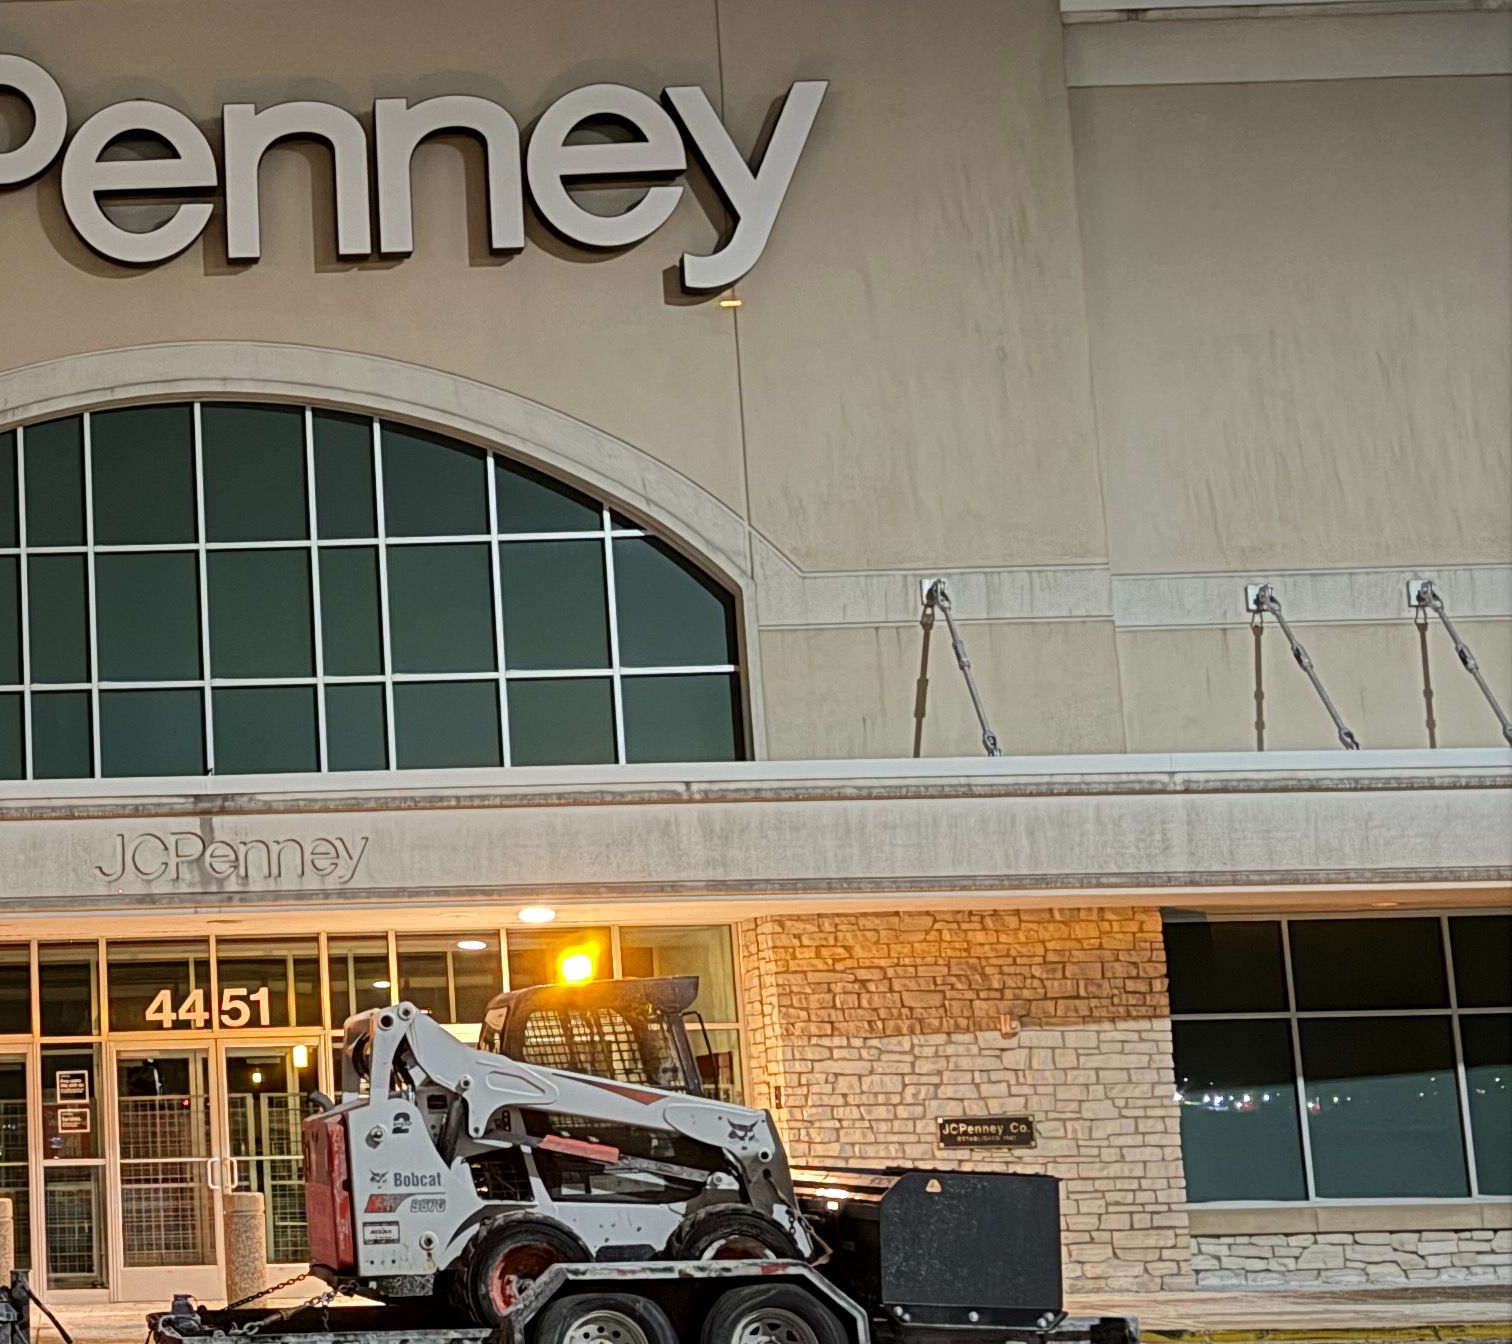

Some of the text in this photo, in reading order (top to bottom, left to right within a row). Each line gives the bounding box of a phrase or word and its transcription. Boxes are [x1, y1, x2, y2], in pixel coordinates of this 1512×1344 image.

[94, 832, 369, 884] JCPenney
[145, 987, 270, 1028] 4451
[942, 1122, 1031, 1136] JCPenney Co.
[393, 1172, 442, 1187] Bobcat
